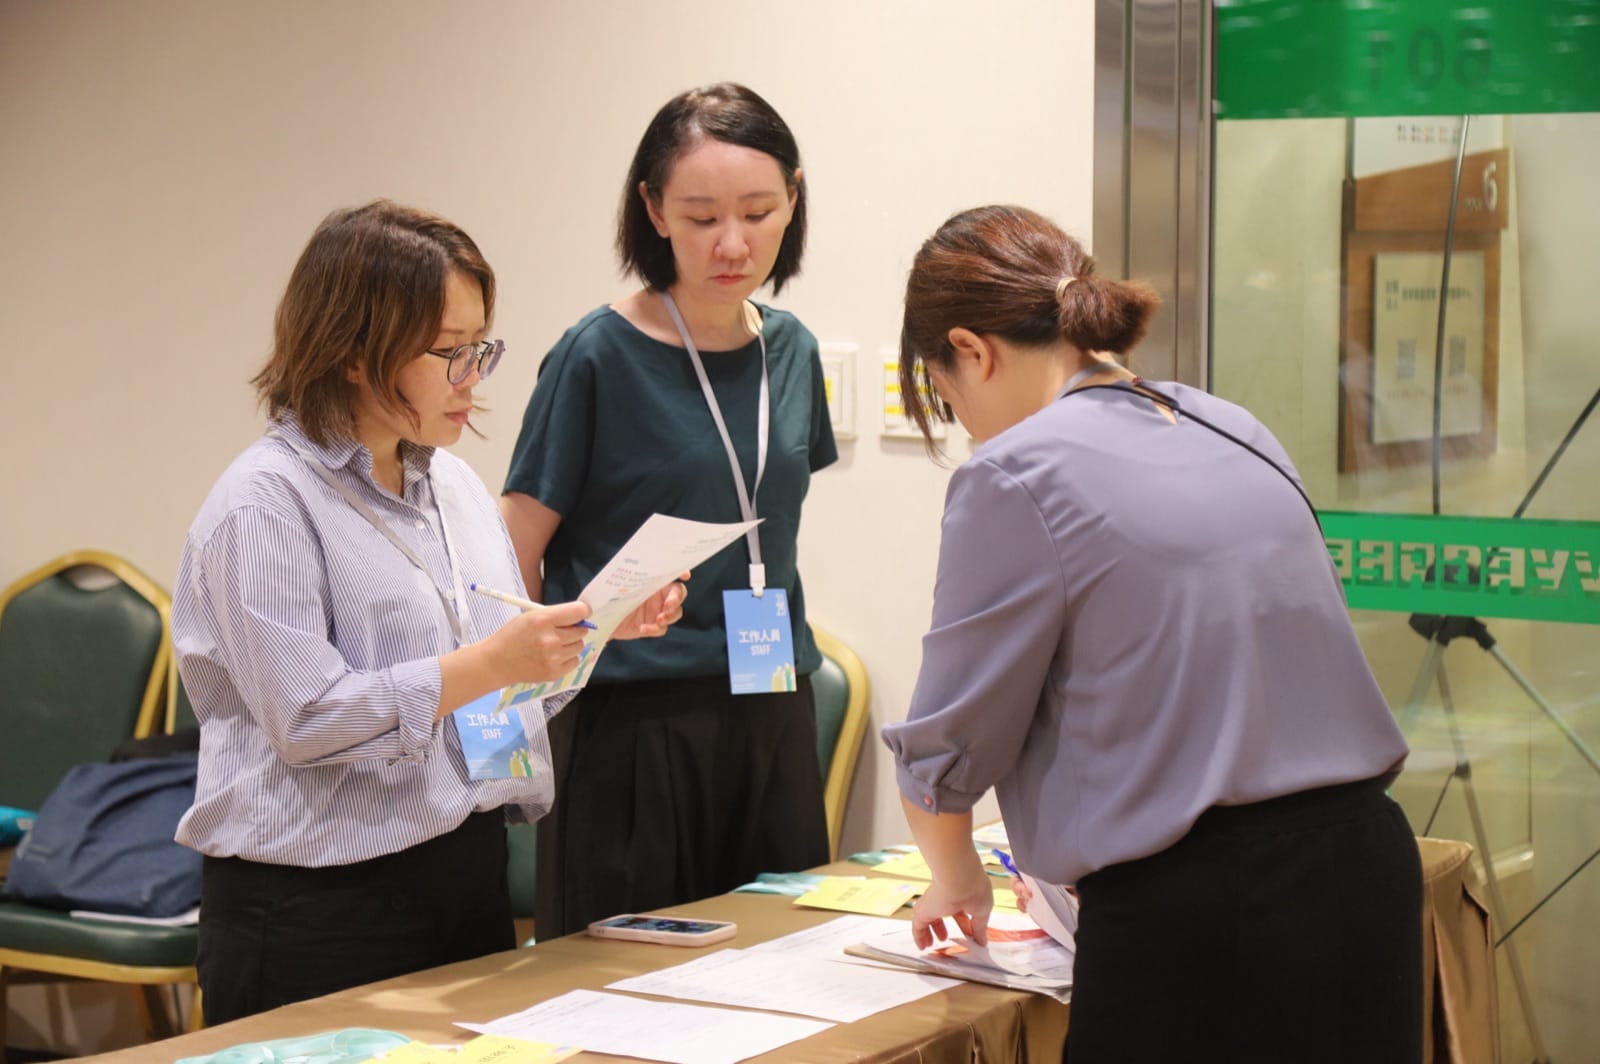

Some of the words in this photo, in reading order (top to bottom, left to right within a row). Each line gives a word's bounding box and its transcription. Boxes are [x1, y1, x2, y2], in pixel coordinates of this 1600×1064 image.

[1482, 160, 1498, 211] 6
[738, 629, 781, 643] 工作人員
[750, 645, 771, 656] STAFF
[466, 711, 510, 727] 工作人員
[481, 728, 503, 740] STAFF
